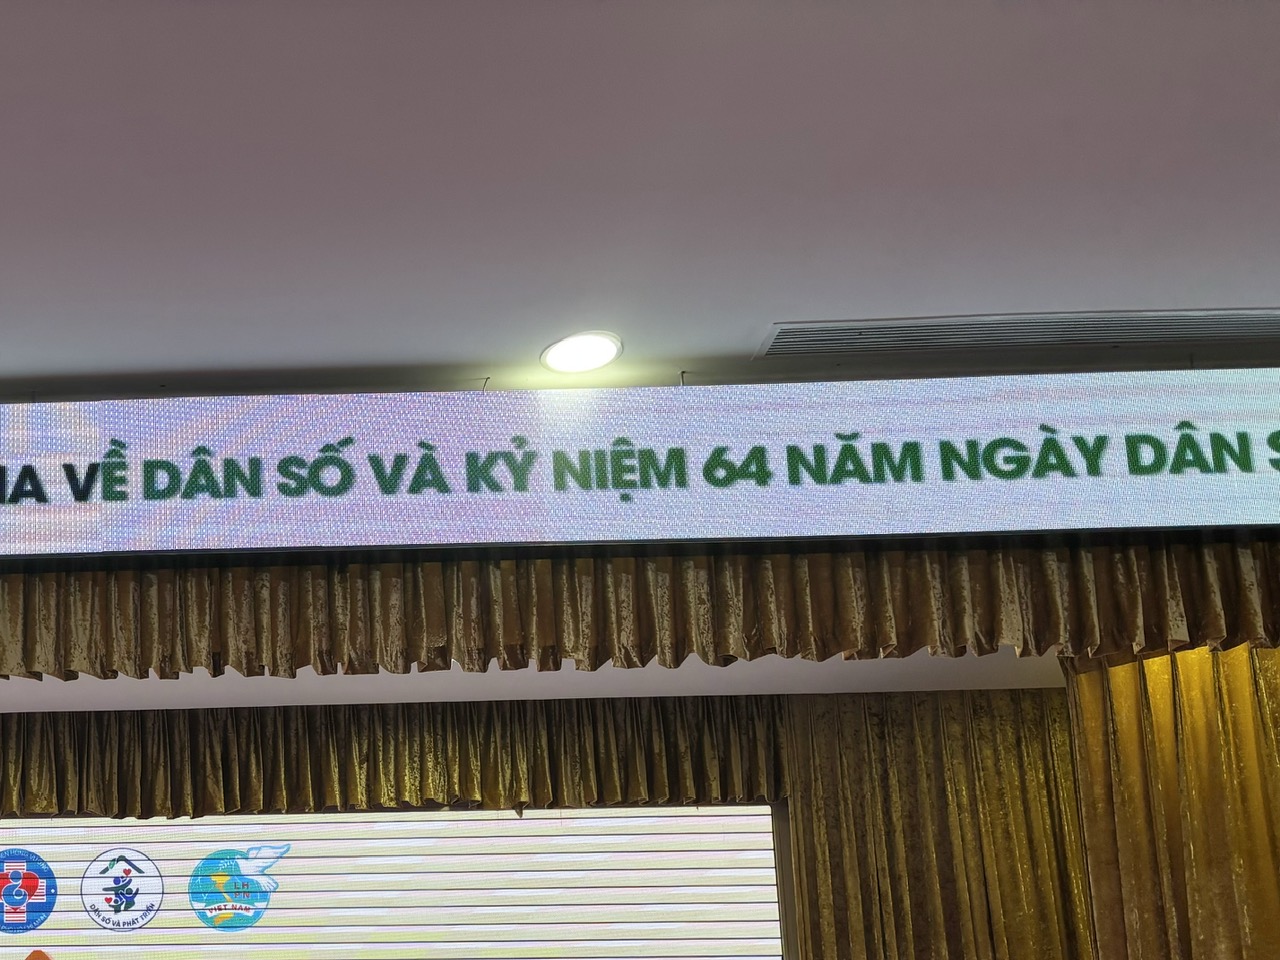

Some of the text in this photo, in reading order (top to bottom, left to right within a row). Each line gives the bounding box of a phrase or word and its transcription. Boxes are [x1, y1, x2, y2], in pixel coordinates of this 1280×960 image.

[62, 438, 129, 504] VỀ
[142, 446, 263, 501] DÂN
[276, 436, 355, 498] SỐ
[370, 441, 450, 495] VÀ
[465, 436, 536, 493] KỶ
[553, 437, 688, 502] NIỆM
[702, 446, 773, 488] 64
[786, 432, 924, 486] NĂM
[939, 424, 1109, 481] NGÀY
[1125, 420, 1253, 477] DÂN
[231, 904, 251, 913] NAM
[100, 916, 112, 925] SỐ
